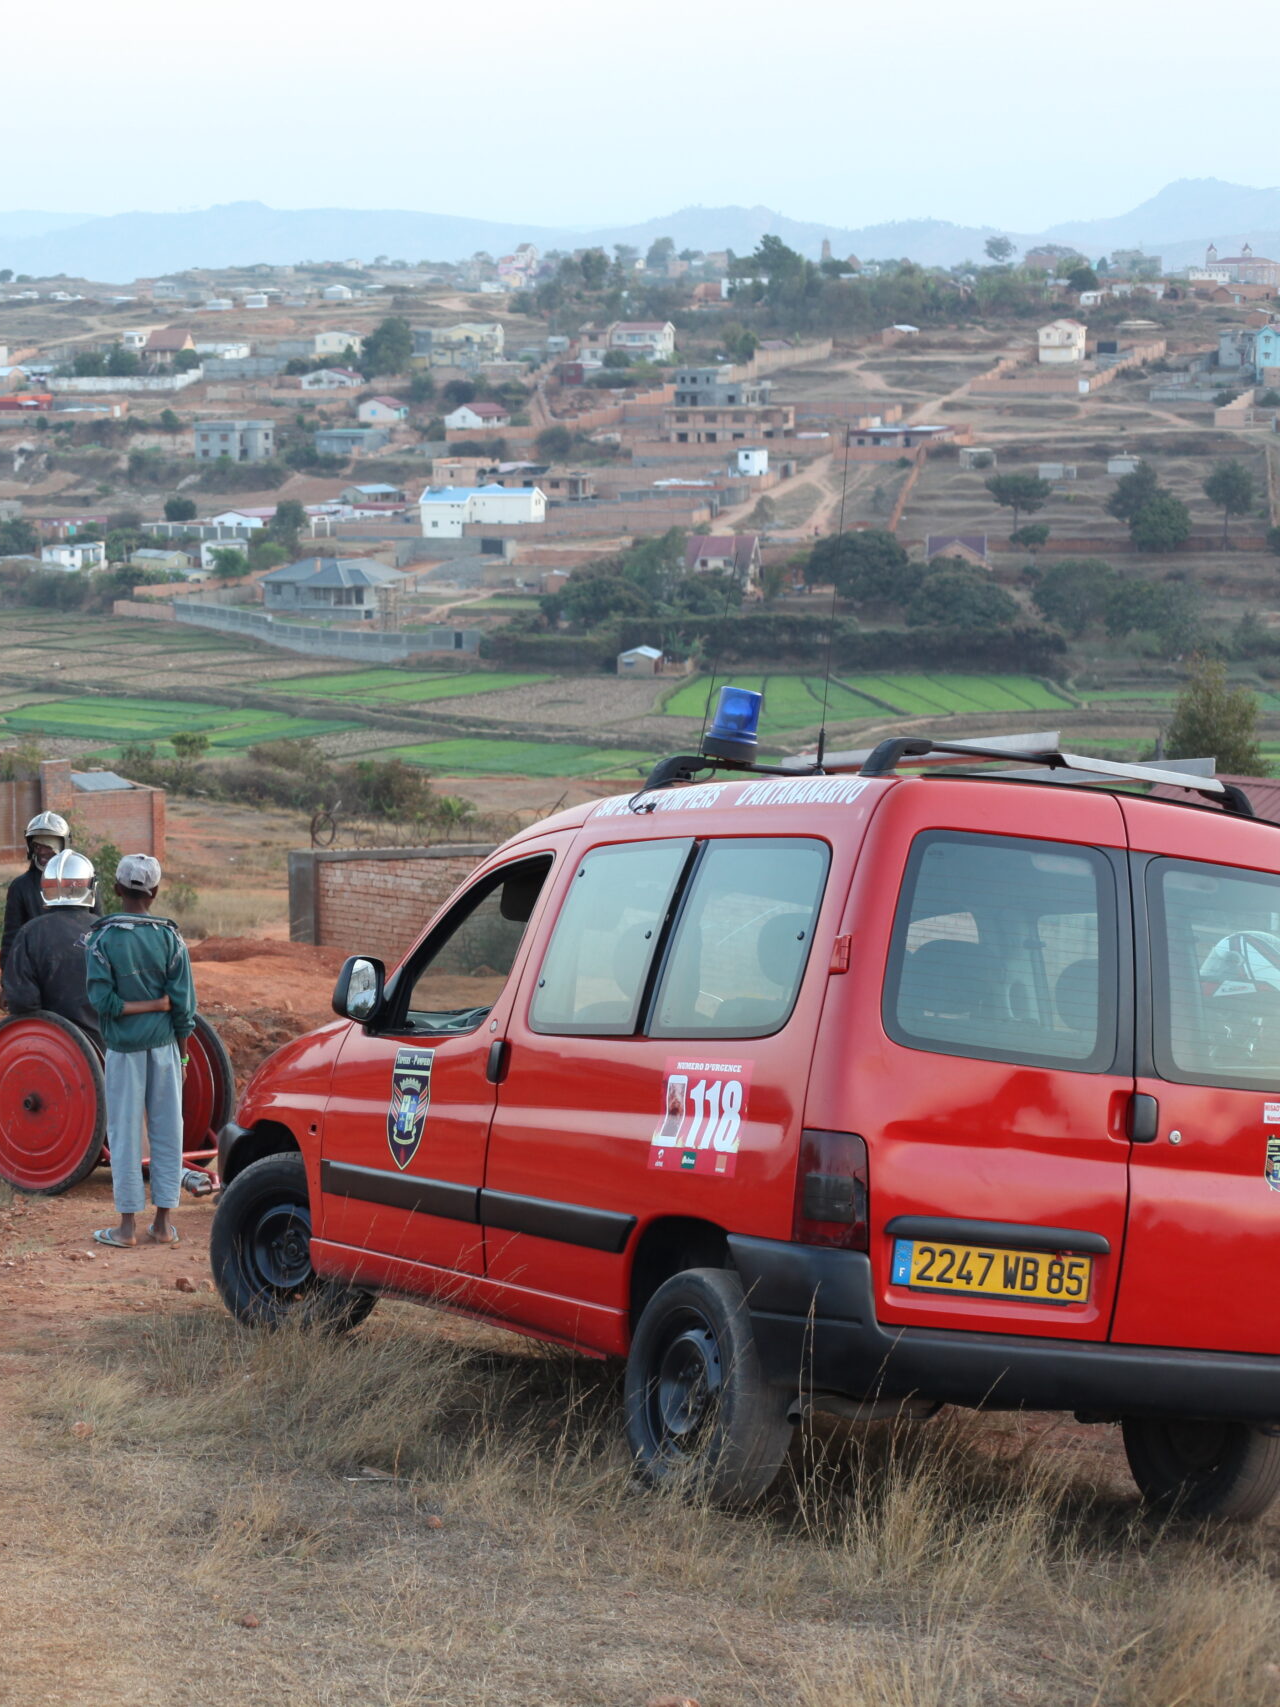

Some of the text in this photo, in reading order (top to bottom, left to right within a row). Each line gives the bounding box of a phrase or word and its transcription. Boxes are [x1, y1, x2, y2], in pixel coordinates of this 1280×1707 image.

[734, 780, 867, 806] D'ANTANANARIVO
[704, 1063, 742, 1073] D'URGENCE
[685, 1079, 743, 1152] 118
[899, 1267, 905, 1277] F
[916, 1246, 1085, 1296] 2247 WB 85
